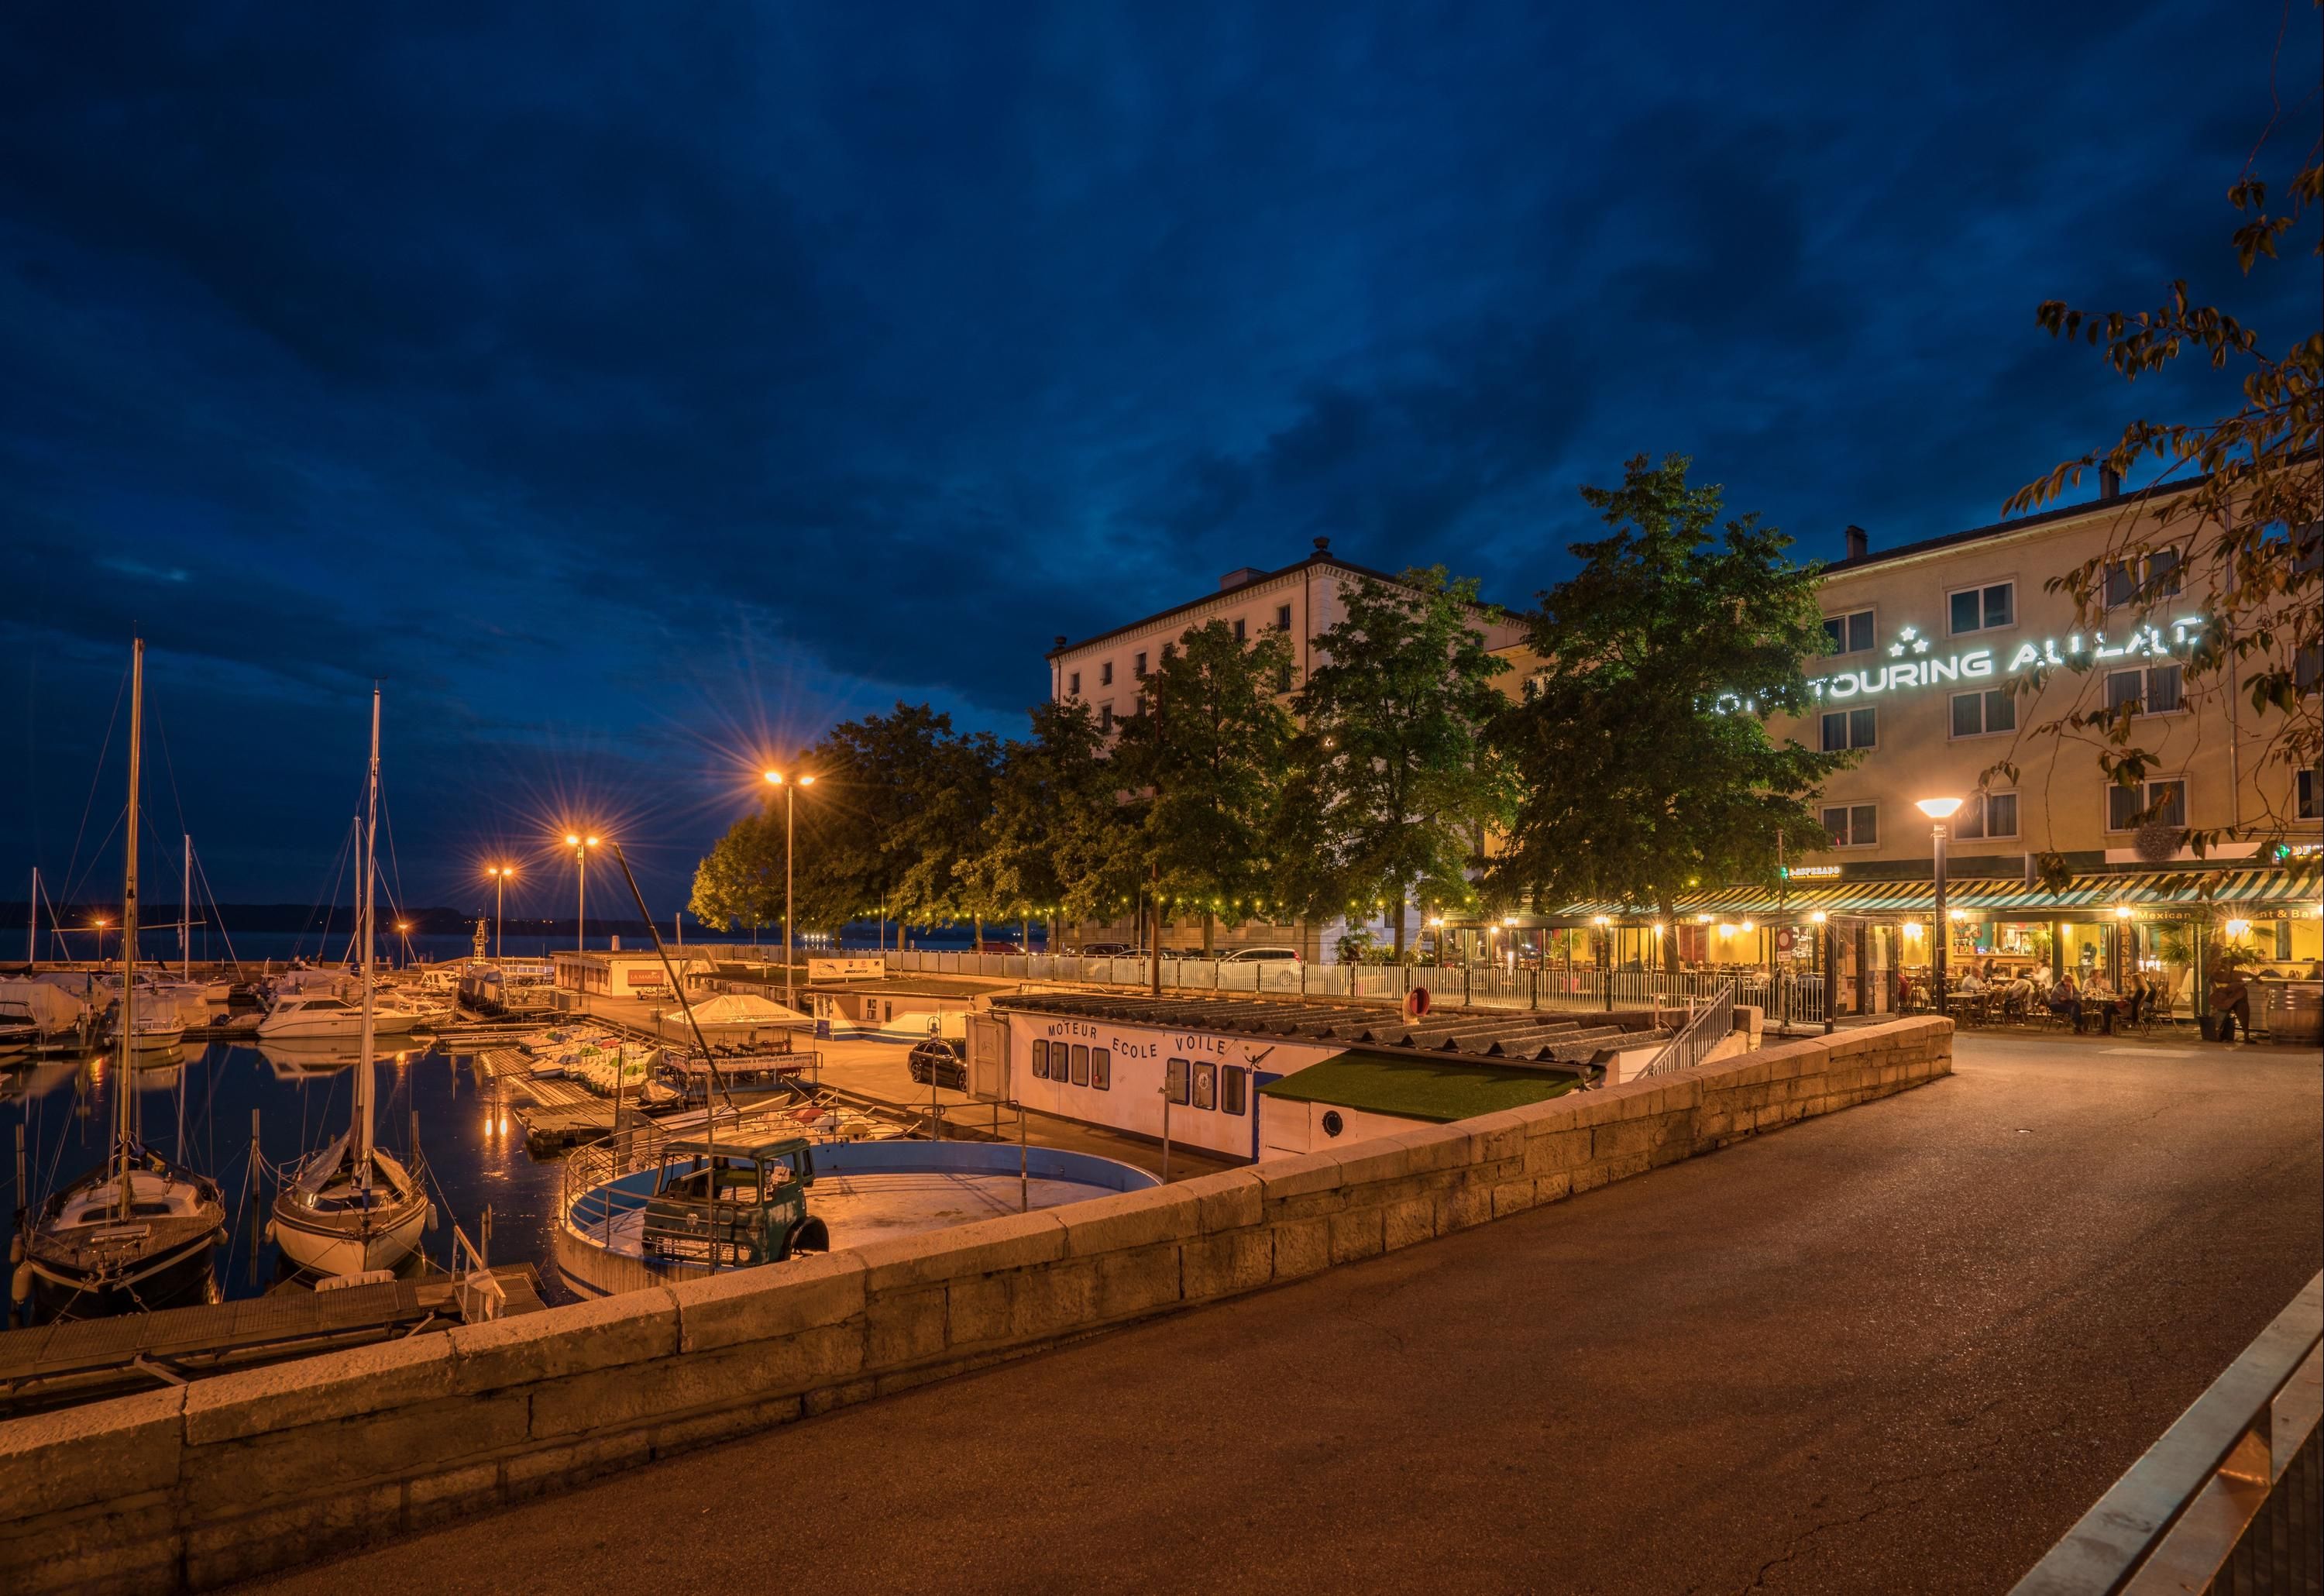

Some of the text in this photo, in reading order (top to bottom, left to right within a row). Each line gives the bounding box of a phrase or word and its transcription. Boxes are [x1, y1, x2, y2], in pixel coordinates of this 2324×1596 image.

[1808, 651, 1992, 700] TOURING
[2137, 911, 2192, 920] Mexican
[1048, 1023, 1226, 1058] MOTEUR ECOLE VOILE
